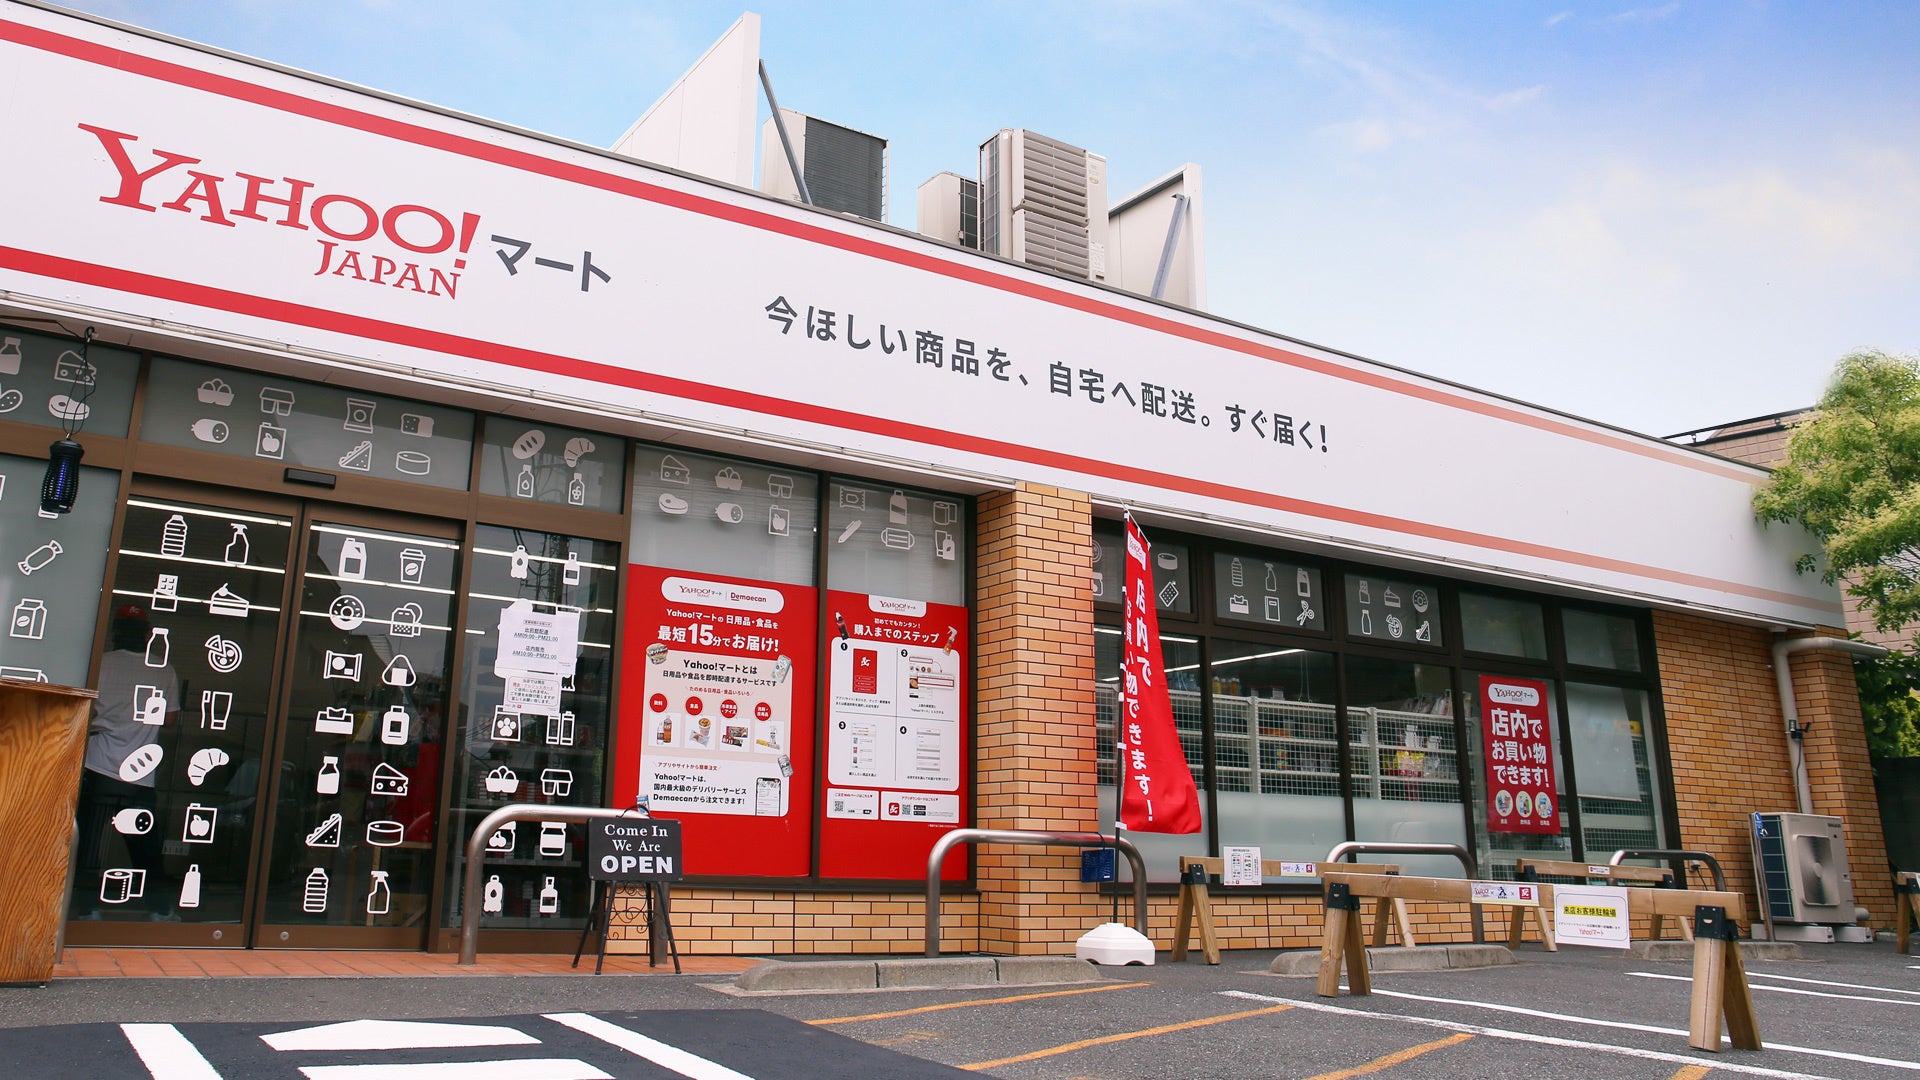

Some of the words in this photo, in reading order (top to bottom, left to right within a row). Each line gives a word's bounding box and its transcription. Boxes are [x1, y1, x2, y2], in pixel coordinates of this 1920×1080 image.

[78, 122, 480, 270] YAHOO!
[491, 234, 611, 292] マート
[314, 239, 461, 300] JAPAN
[731, 592, 767, 602] Demaecan
[657, 623, 779, 652] 最短15分でお届け!
[853, 623, 940, 643] 購入までのステップ
[683, 659, 758, 675] Yahoo!マートとは
[1491, 708, 1542, 739] 店内で
[1492, 740, 1547, 764] お買い物
[1493, 765, 1549, 788] できます!
[653, 783, 747, 795] 国内最大級のデリバリーサービス
[653, 793, 745, 805] Demaecanから注文できます!
[604, 824, 648, 836] Come
[651, 825, 668, 837] In
[612, 839, 632, 852] We
[638, 840, 661, 852] Are
[601, 855, 673, 874] OPEN
[1564, 905, 1616, 918] 来店お客様駐輪場
